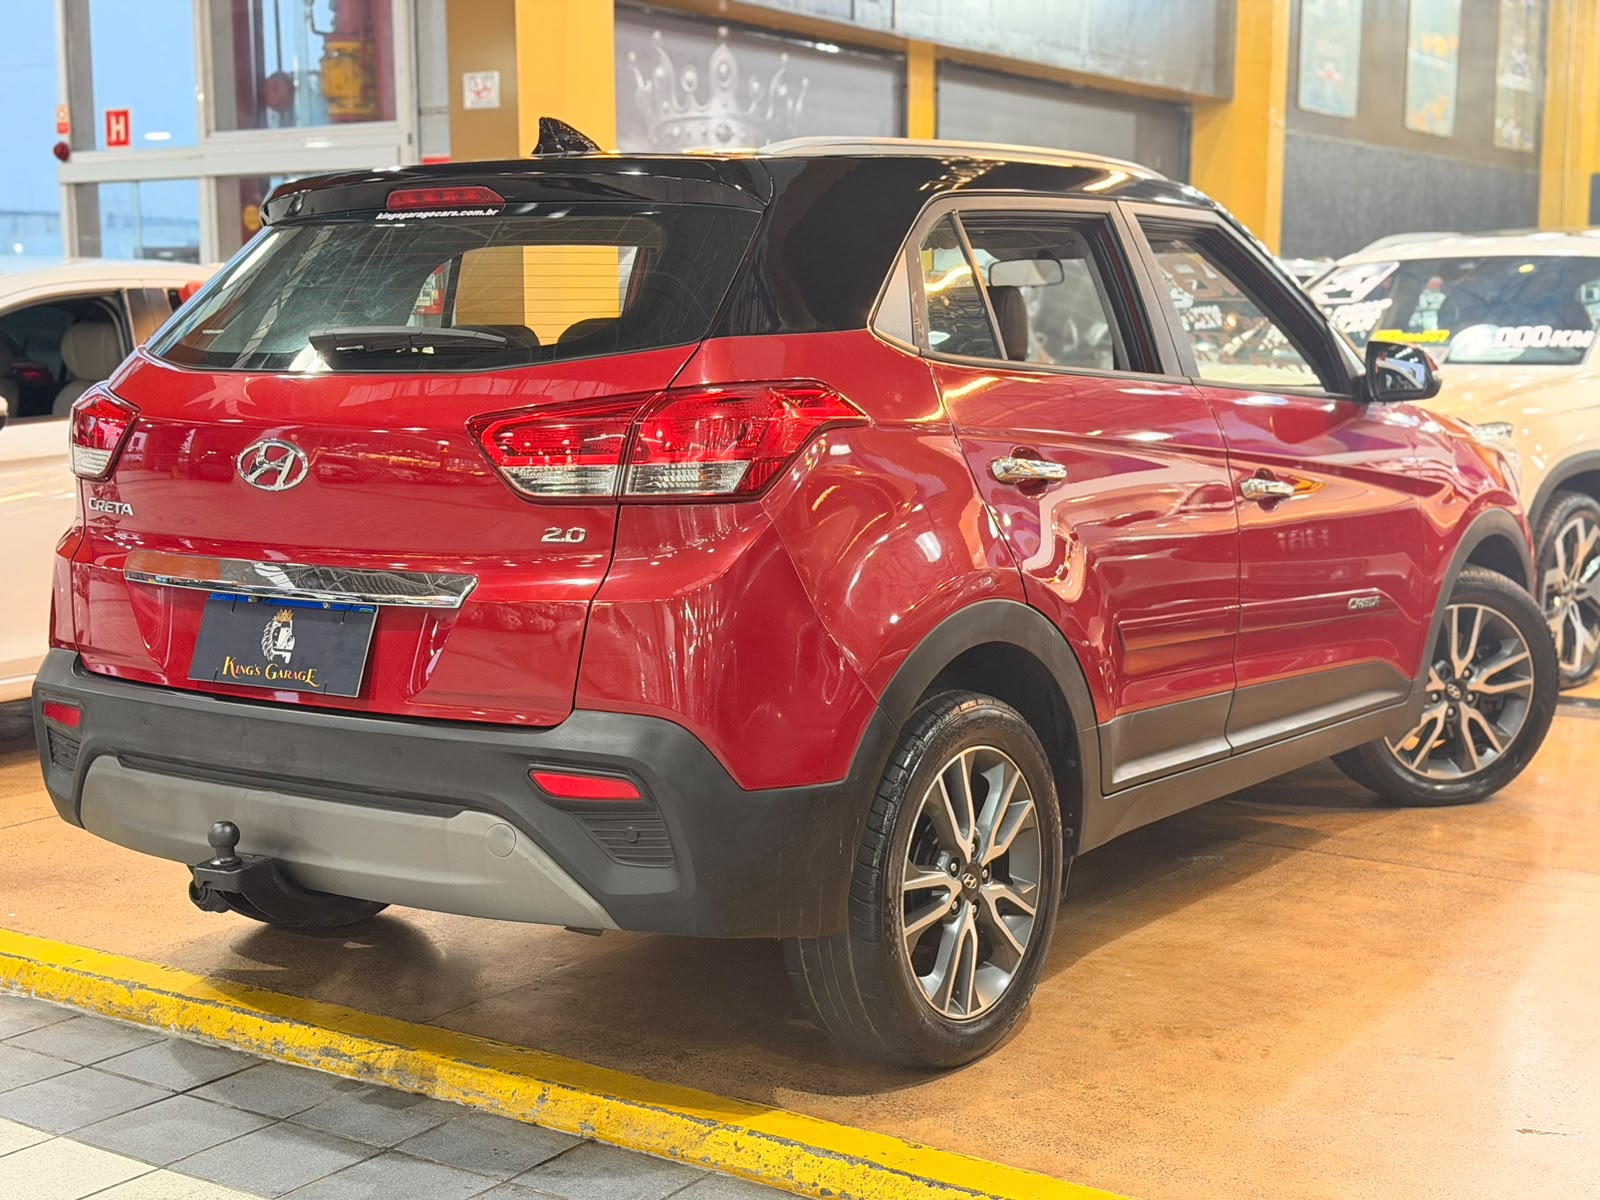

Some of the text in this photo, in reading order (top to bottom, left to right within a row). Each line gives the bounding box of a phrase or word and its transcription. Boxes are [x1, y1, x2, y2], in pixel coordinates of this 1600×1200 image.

[110, 114, 126, 142] H
[375, 208, 499, 220] kingsgaragecars.com.br
[88, 497, 134, 516] CRETA
[541, 527, 586, 543] 2.0
